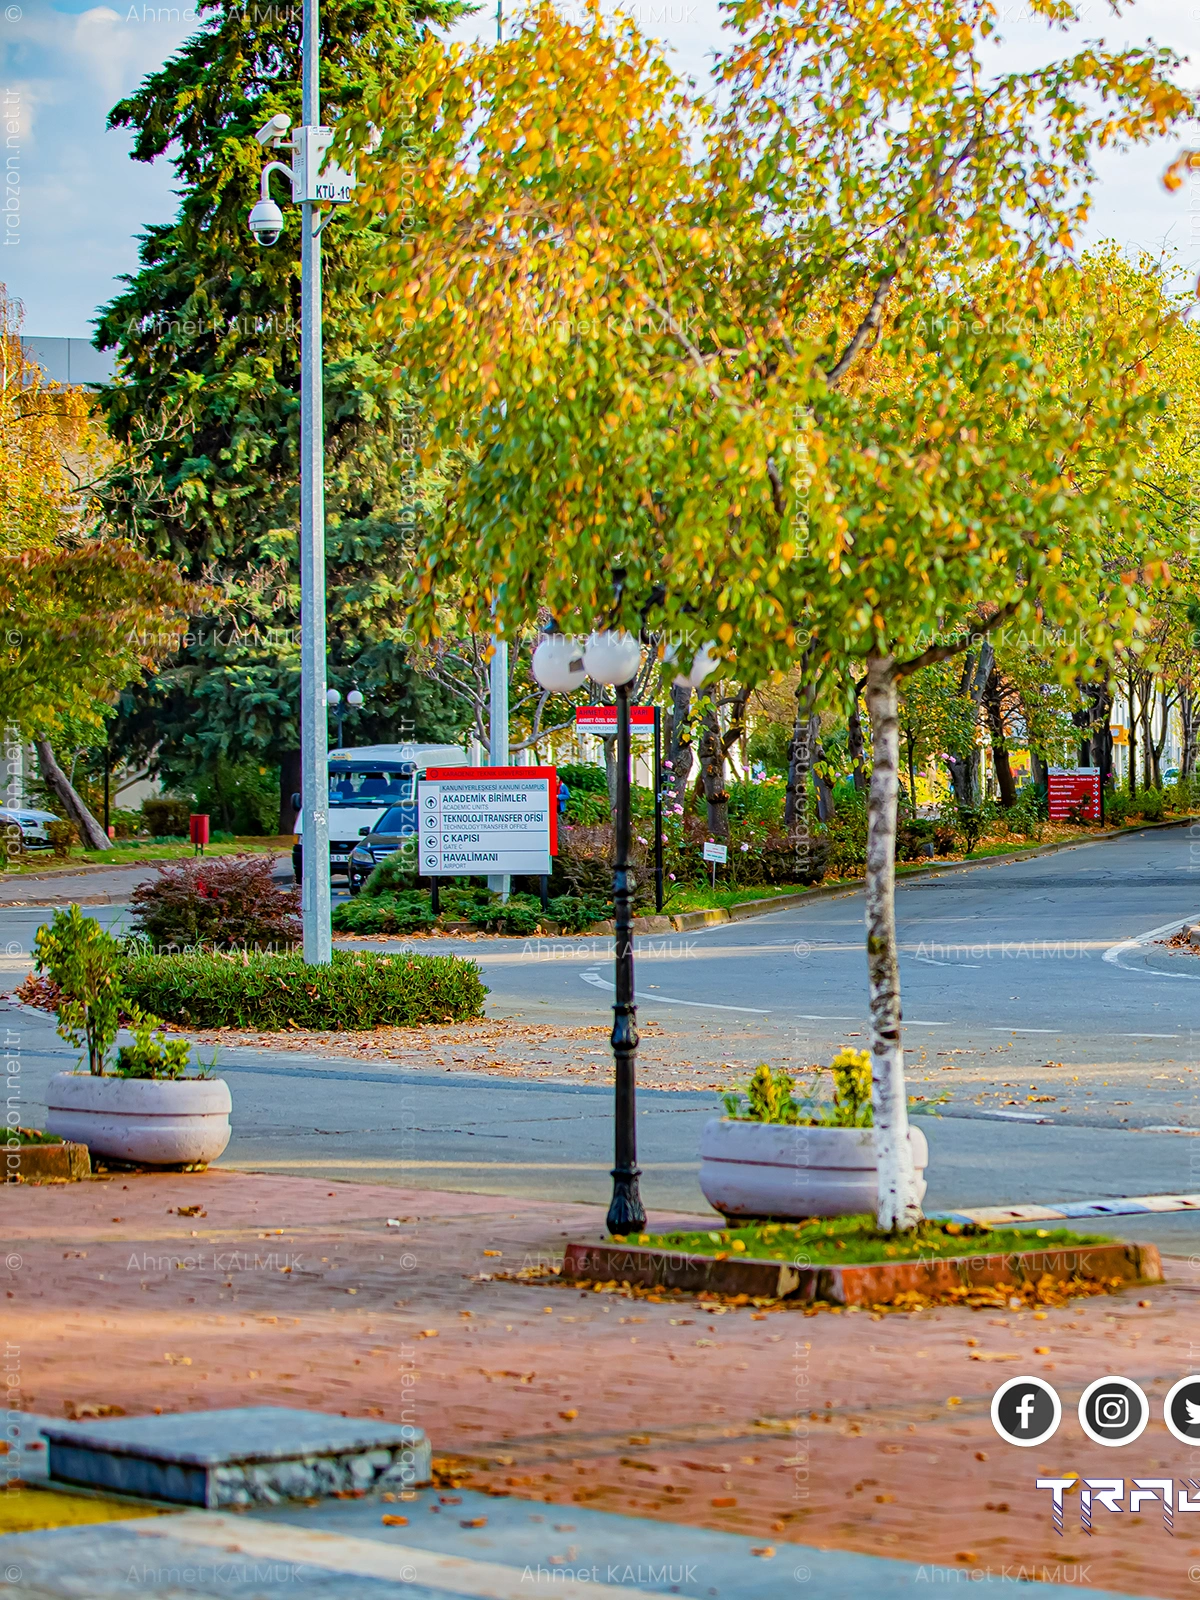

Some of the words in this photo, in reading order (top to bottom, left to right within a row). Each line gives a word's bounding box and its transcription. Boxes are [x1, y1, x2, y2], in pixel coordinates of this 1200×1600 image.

[316, 182, 334, 198] KTÜ
[443, 793, 486, 803] AKADEMİK
[489, 793, 527, 802] BİRİMLER
[443, 812, 483, 822] TEKNOLOJİ
[485, 814, 522, 822] TRANSFER
[524, 812, 543, 822] OFİSİ
[443, 852, 498, 862] HAVALİMANI
